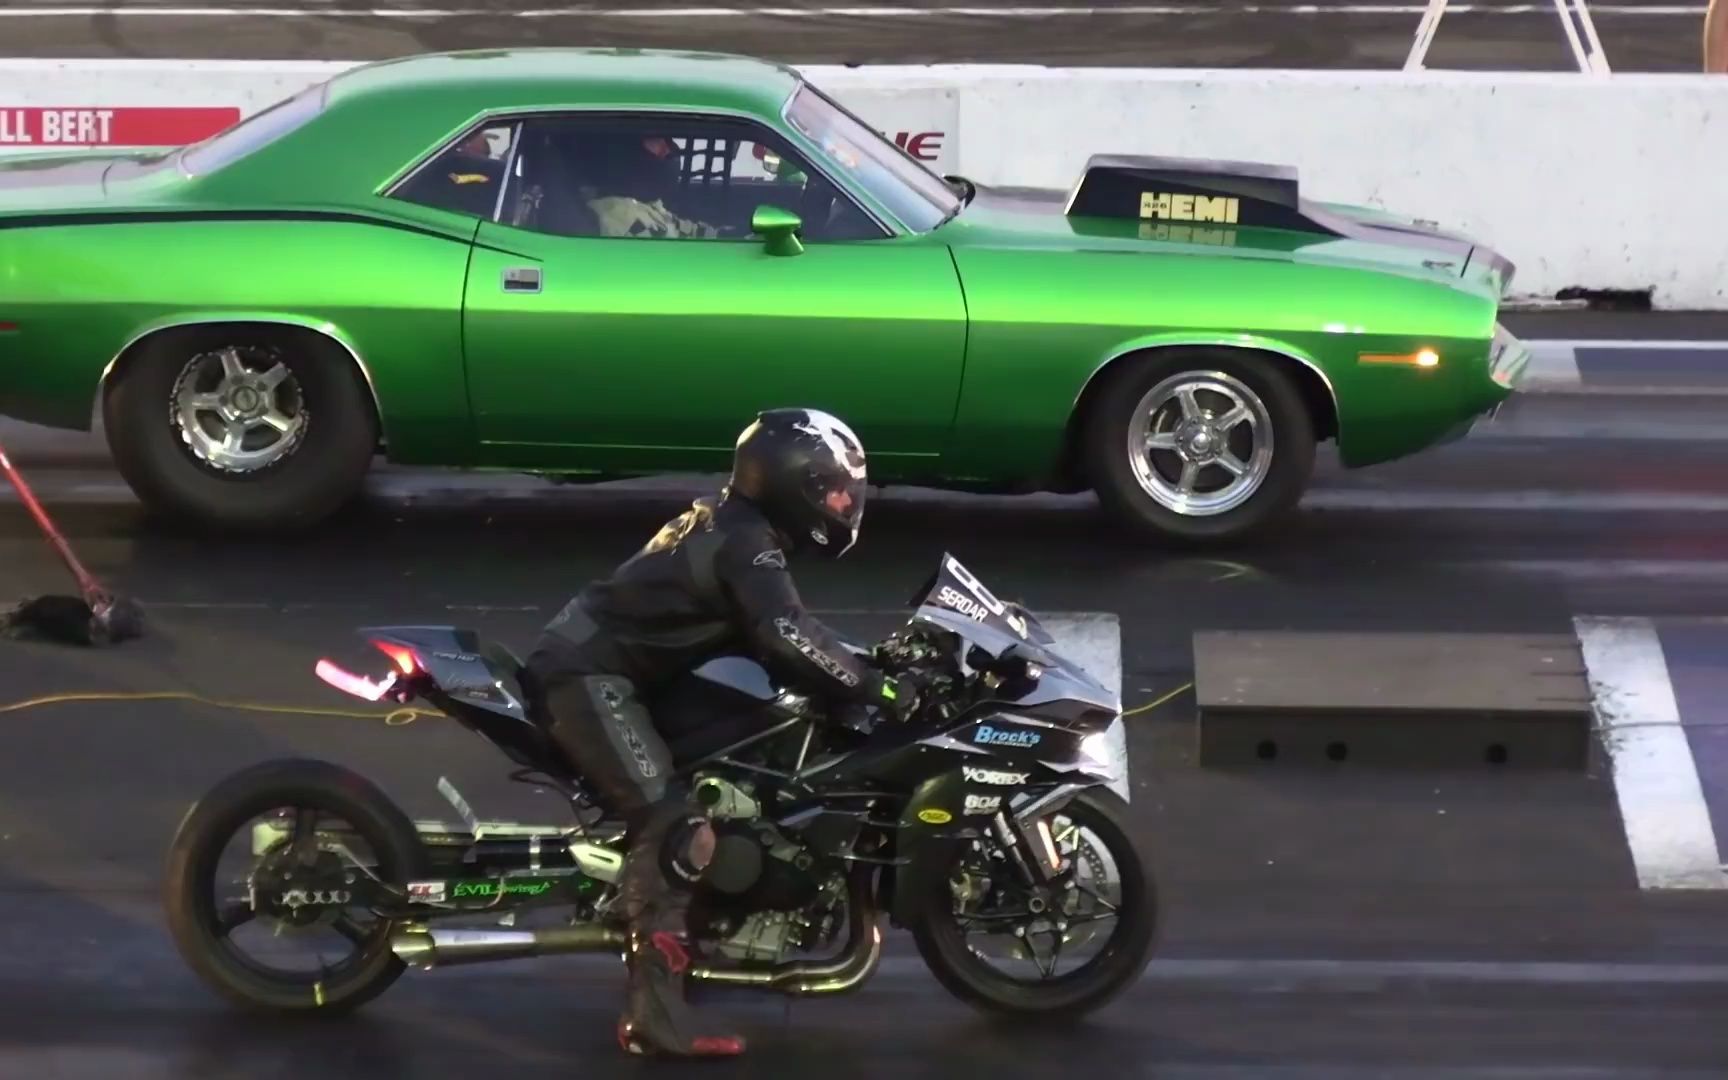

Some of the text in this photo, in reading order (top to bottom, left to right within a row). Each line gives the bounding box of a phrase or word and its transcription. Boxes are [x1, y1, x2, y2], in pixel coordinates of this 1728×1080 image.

[42, 109, 113, 143] BERT
[1140, 191, 1239, 224] HEMI
[938, 586, 989, 622] SERDAR
[974, 725, 1041, 744] Brock's
[962, 765, 1031, 785] VORTEX
